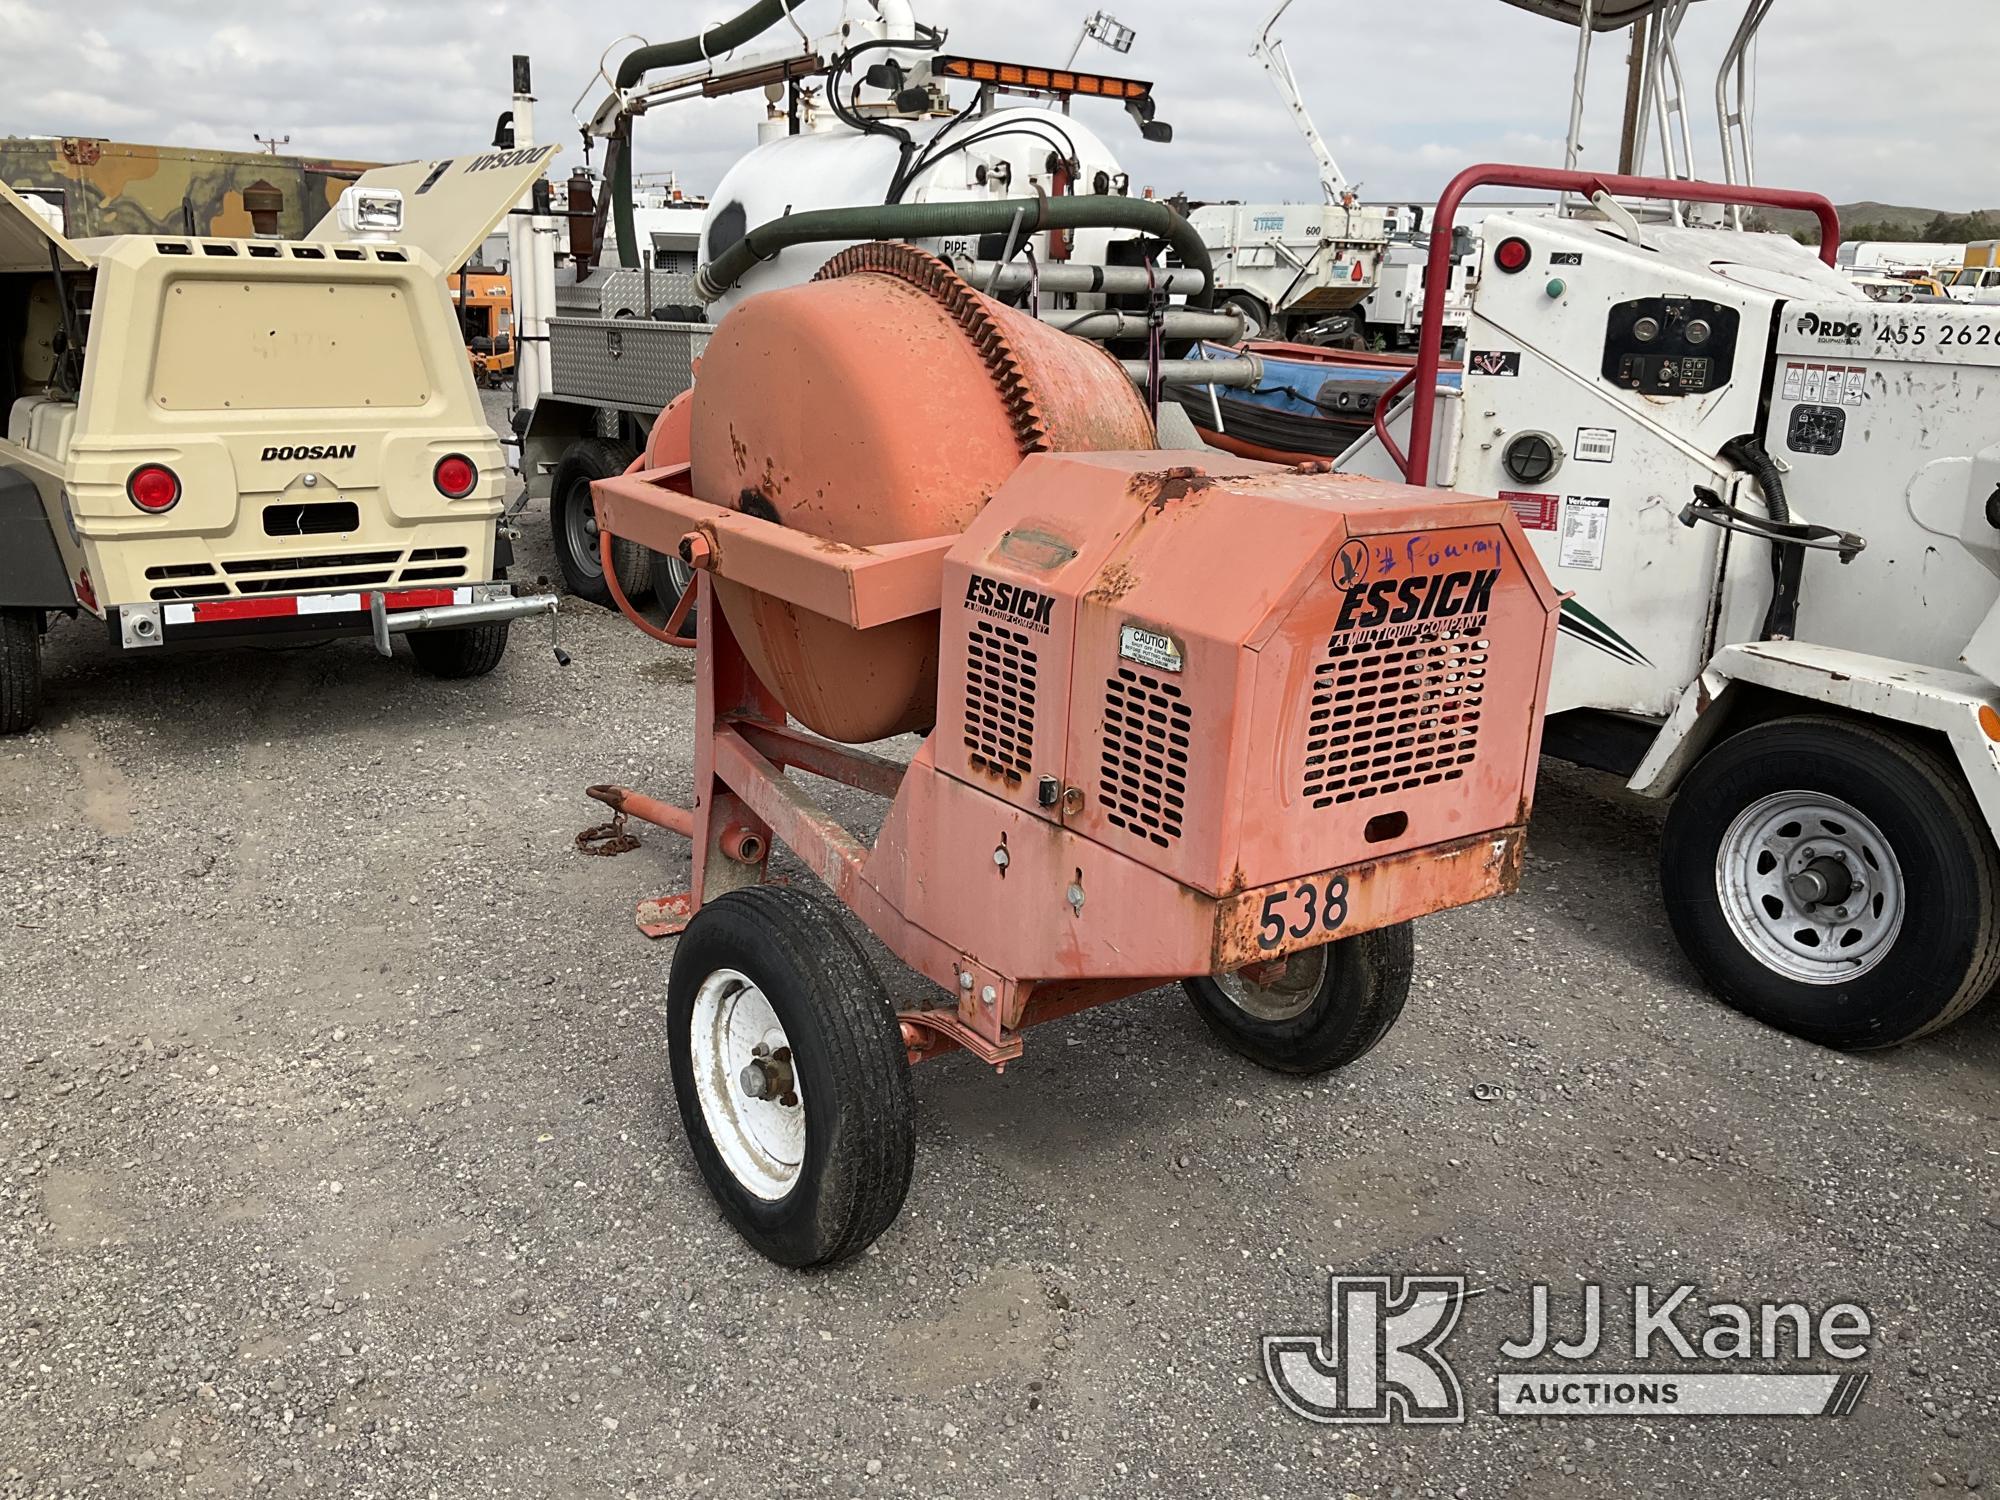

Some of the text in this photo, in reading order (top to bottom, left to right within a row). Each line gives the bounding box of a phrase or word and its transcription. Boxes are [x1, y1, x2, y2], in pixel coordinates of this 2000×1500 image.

[464, 145, 552, 173] DOOSAN
[1306, 226, 1321, 235] 600
[1877, 324, 1926, 345] 455
[261, 445, 356, 461] DOOSAN
[1568, 497, 1600, 506] Vermeer
[966, 574, 1056, 625] ESSICK
[1333, 569, 1501, 631] ESSICK
[1335, 614, 1483, 647] A MULTIQUIP COMPANY
[1257, 875, 1348, 950] 538
